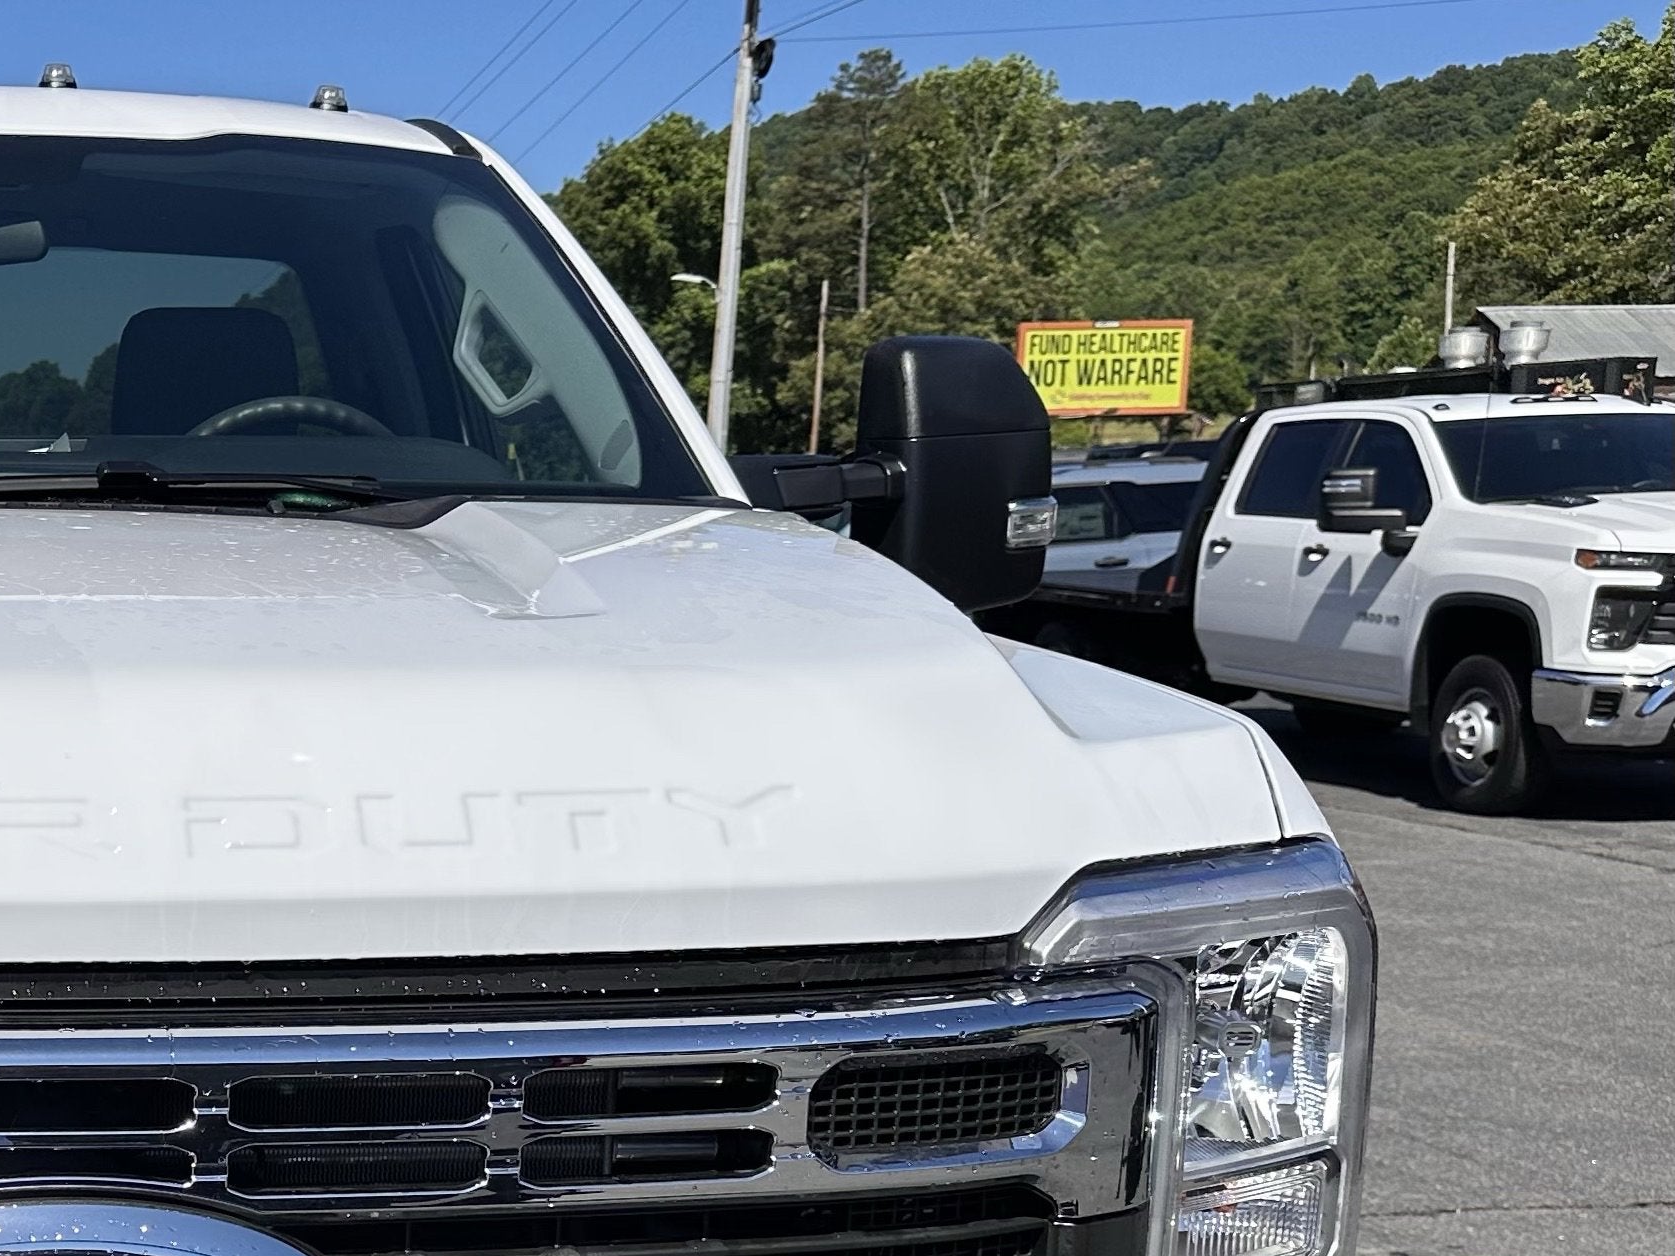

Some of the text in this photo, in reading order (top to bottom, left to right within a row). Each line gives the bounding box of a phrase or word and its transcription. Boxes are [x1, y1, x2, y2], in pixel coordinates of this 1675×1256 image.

[1028, 331, 1181, 356] FUND HEALTHCARE
[1028, 357, 1179, 387] NOT WARFARE
[179, 782, 801, 860] DUTY
